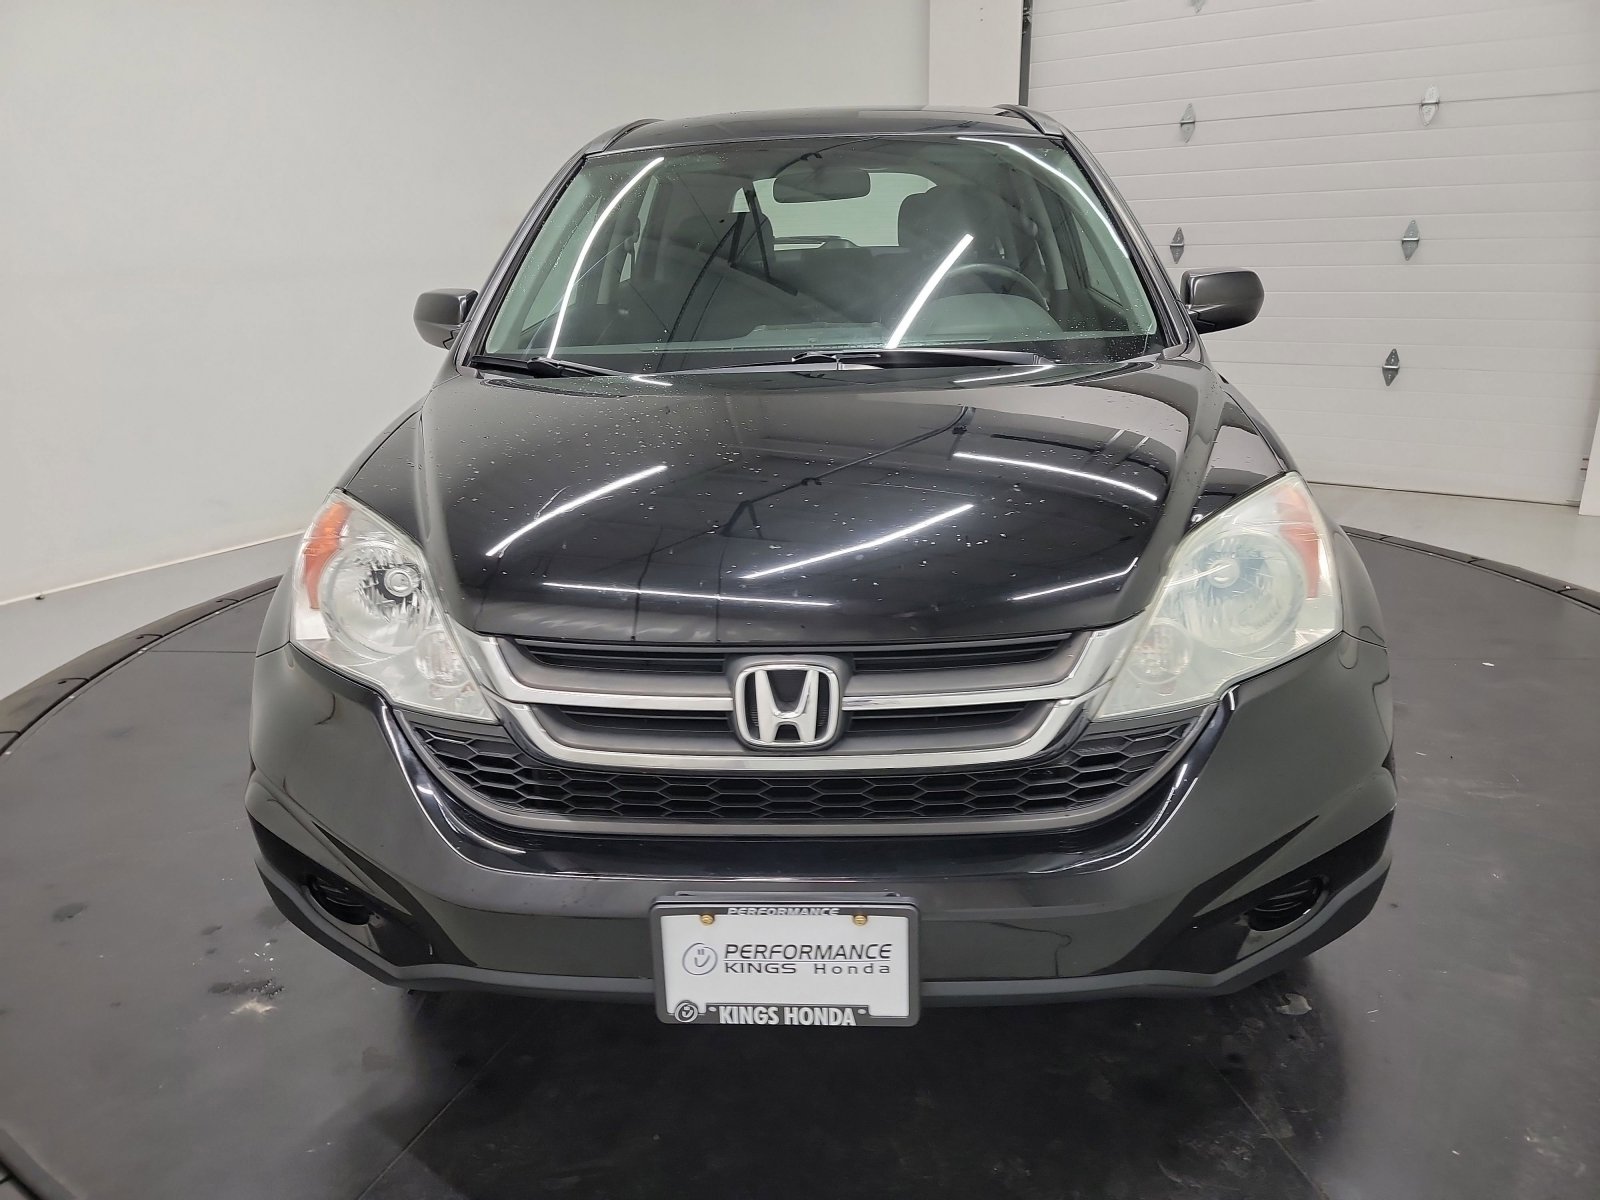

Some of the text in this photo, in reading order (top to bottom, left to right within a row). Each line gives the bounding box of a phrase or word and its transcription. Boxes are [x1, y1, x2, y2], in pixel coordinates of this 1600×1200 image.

[728, 907, 840, 916] PERFORMANCE
[724, 944, 892, 960] PERFORMANCE
[725, 963, 890, 975] KINGS Honda
[719, 1006, 856, 1026] KINGS HONDA
